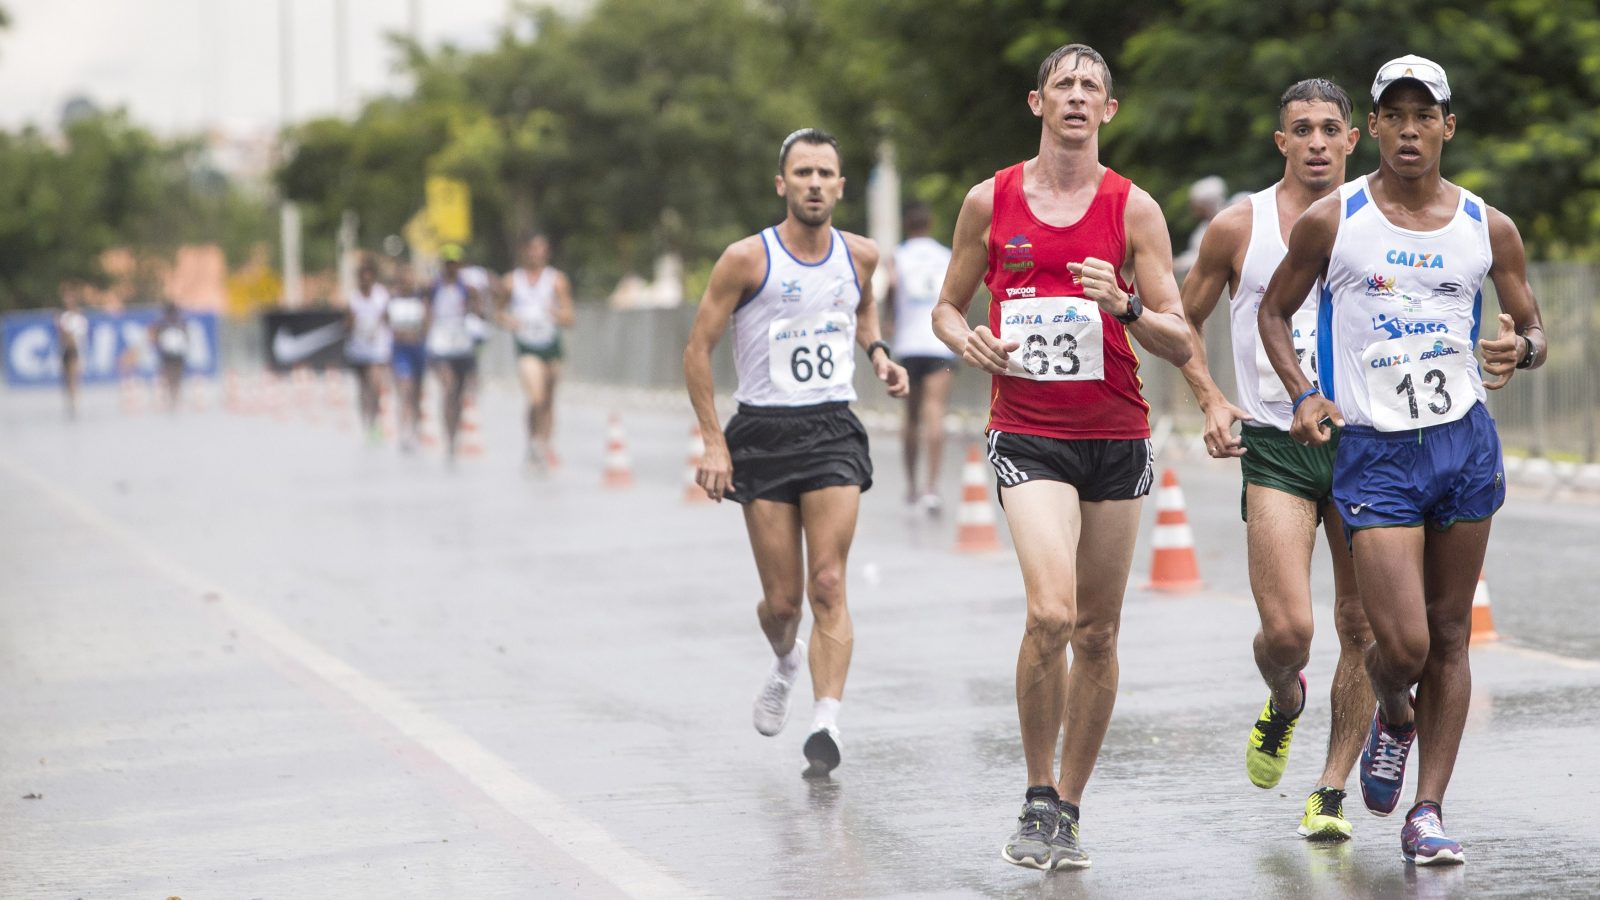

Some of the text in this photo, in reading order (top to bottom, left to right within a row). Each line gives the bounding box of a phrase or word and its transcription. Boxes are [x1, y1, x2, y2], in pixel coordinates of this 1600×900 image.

[1387, 249, 1444, 268] CAIXA
[1005, 315, 1043, 325] CAIXA
[791, 344, 834, 382] 68
[1022, 333, 1080, 375] 63
[1371, 347, 1460, 368] CAIXA BRASIL
[1396, 369, 1452, 419] 13
